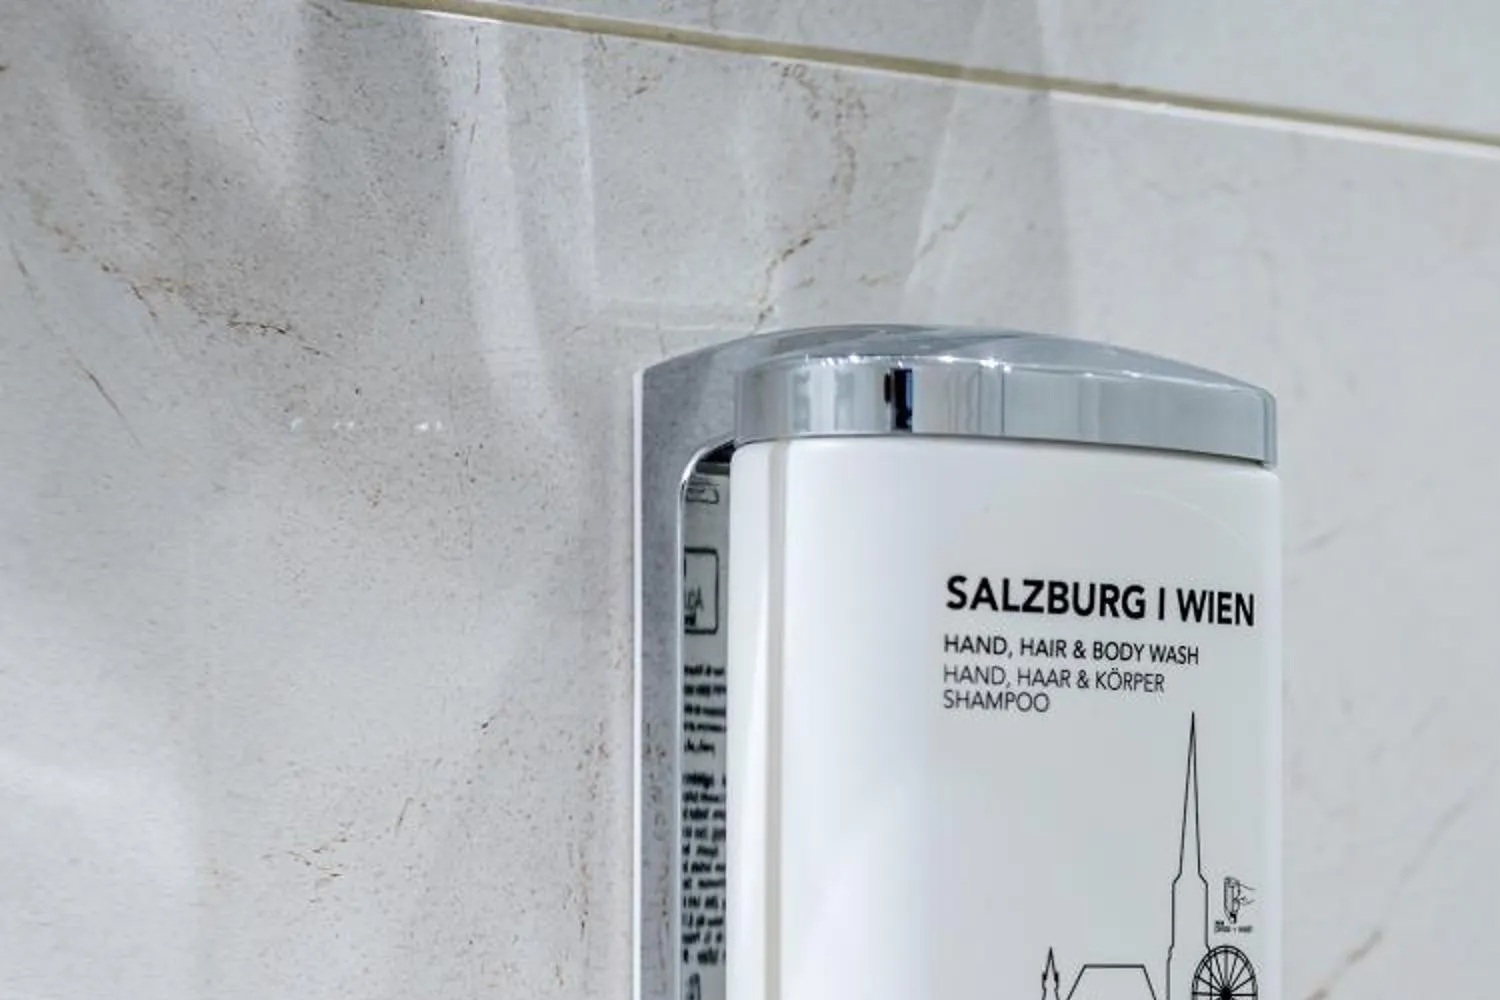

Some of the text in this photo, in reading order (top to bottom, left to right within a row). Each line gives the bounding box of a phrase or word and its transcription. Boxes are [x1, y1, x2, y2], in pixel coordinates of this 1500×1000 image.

[946, 574, 1147, 620] SALZBURG
[1176, 588, 1255, 627] WIEN
[943, 634, 1199, 665] HAND, HAIR & BODY WASH
[943, 664, 1165, 693] HAND, HAAR & KÖRPER
[943, 689, 1050, 713] SHAMPOO
